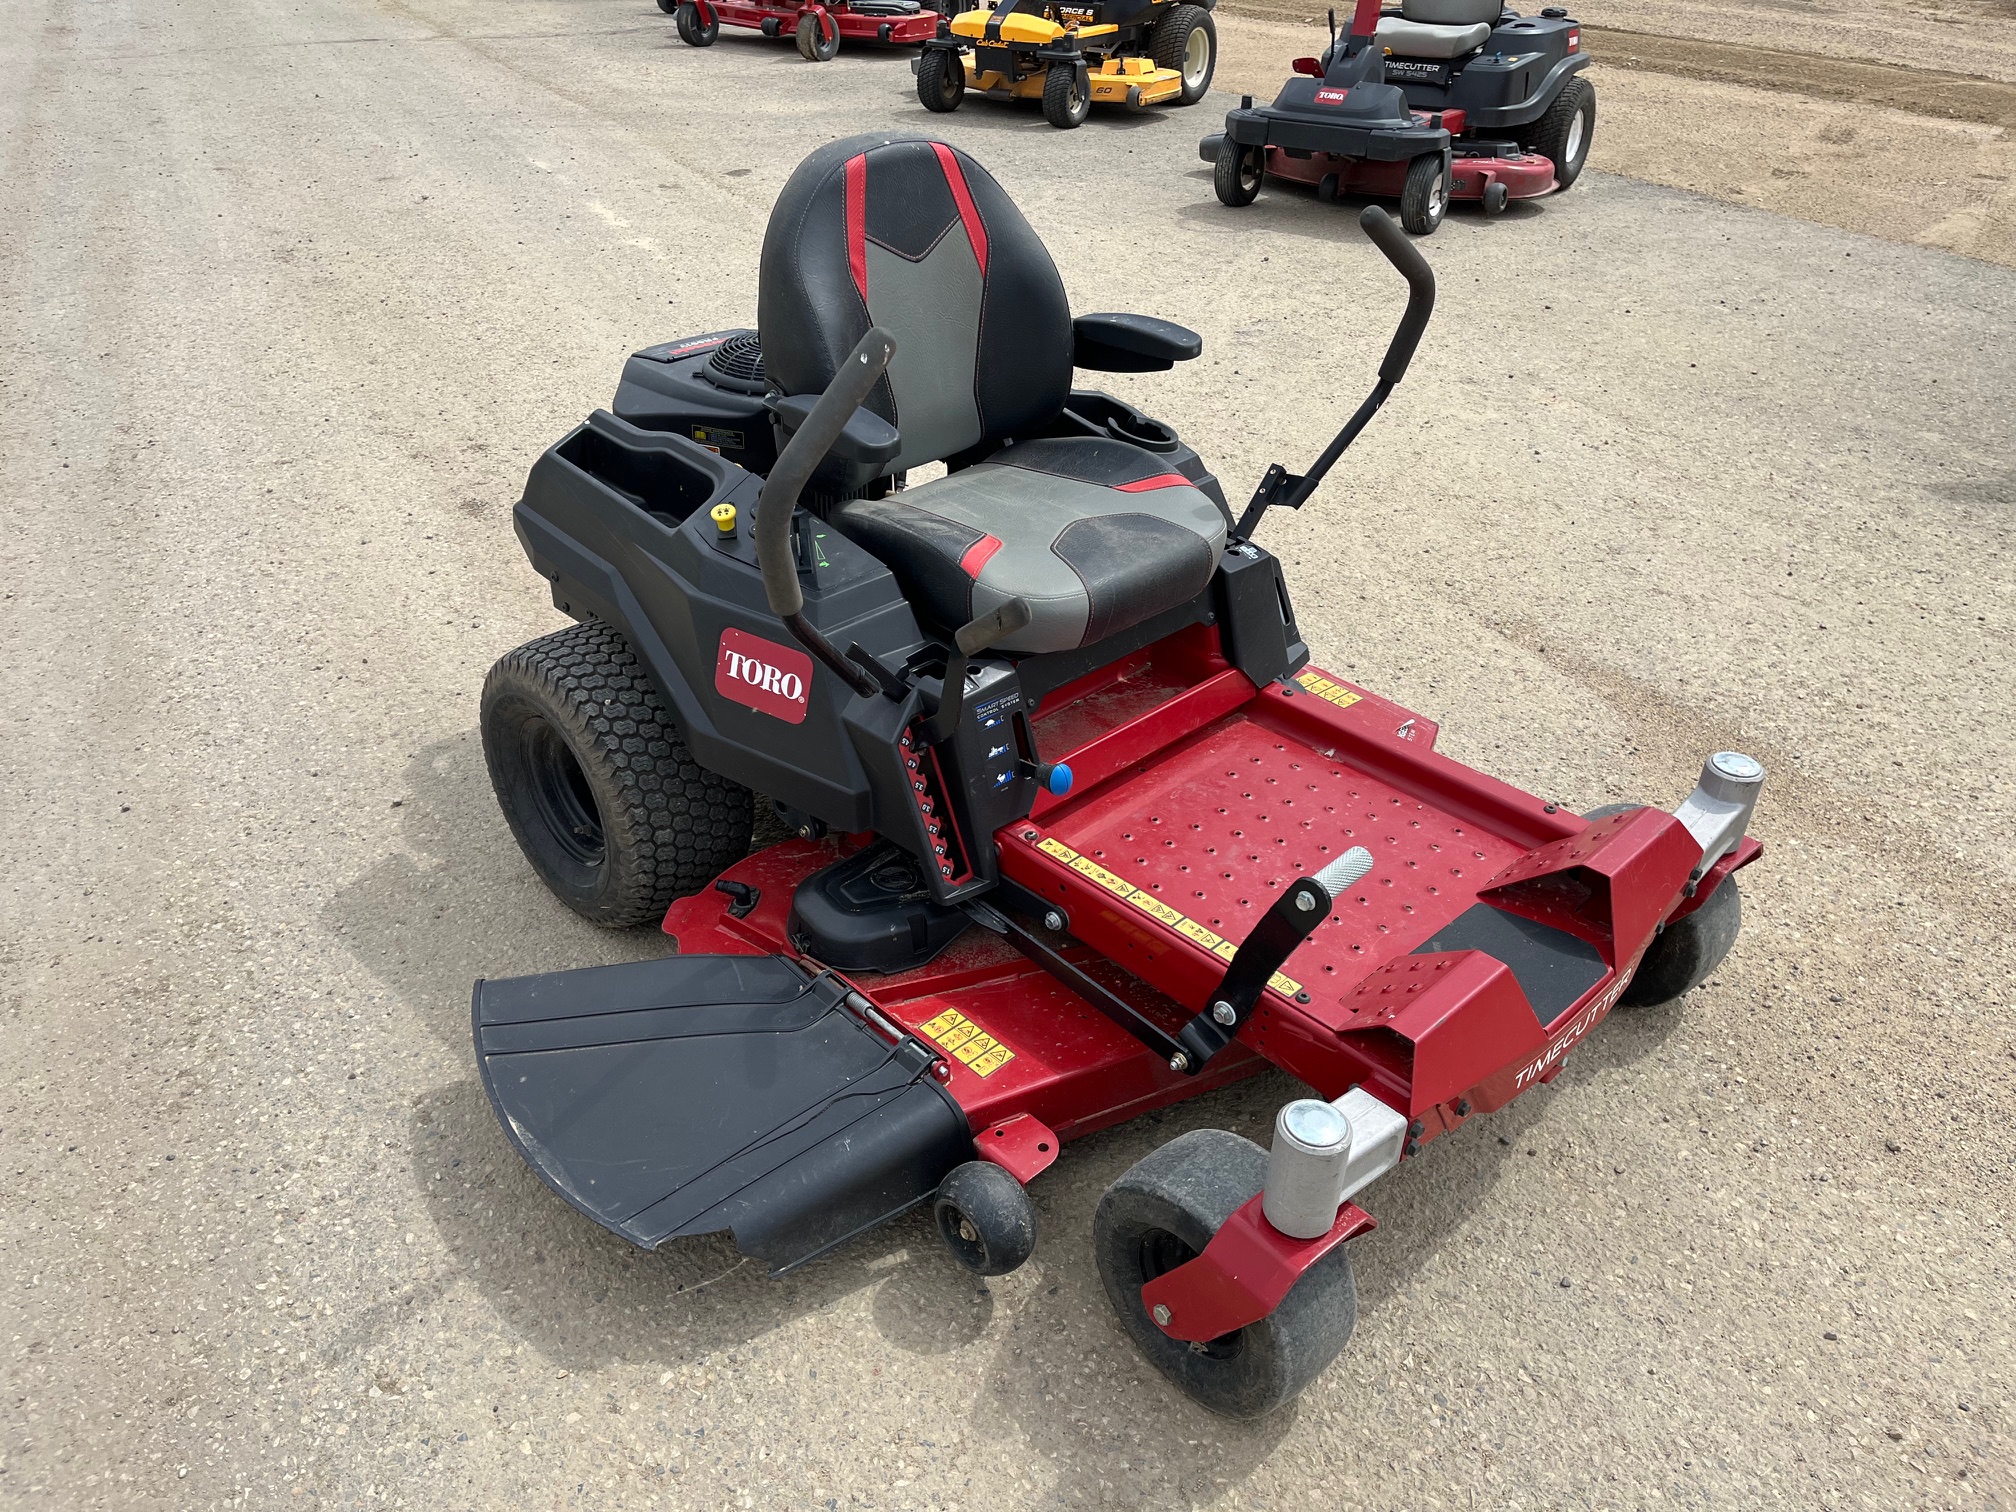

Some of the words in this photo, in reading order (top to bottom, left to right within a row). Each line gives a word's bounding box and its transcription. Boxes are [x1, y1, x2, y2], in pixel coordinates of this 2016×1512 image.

[1384, 61, 1440, 72] TIMECUTTER
[1319, 91, 1344, 100] TORO
[725, 650, 803, 701] TORO
[976, 700, 999, 715] SMART
[999, 692, 1019, 705] SPEED
[976, 707, 999, 719] CONTROL
[1000, 698, 1020, 709] SYSTEM
[1515, 968, 1633, 1089] TIMECUTTER
